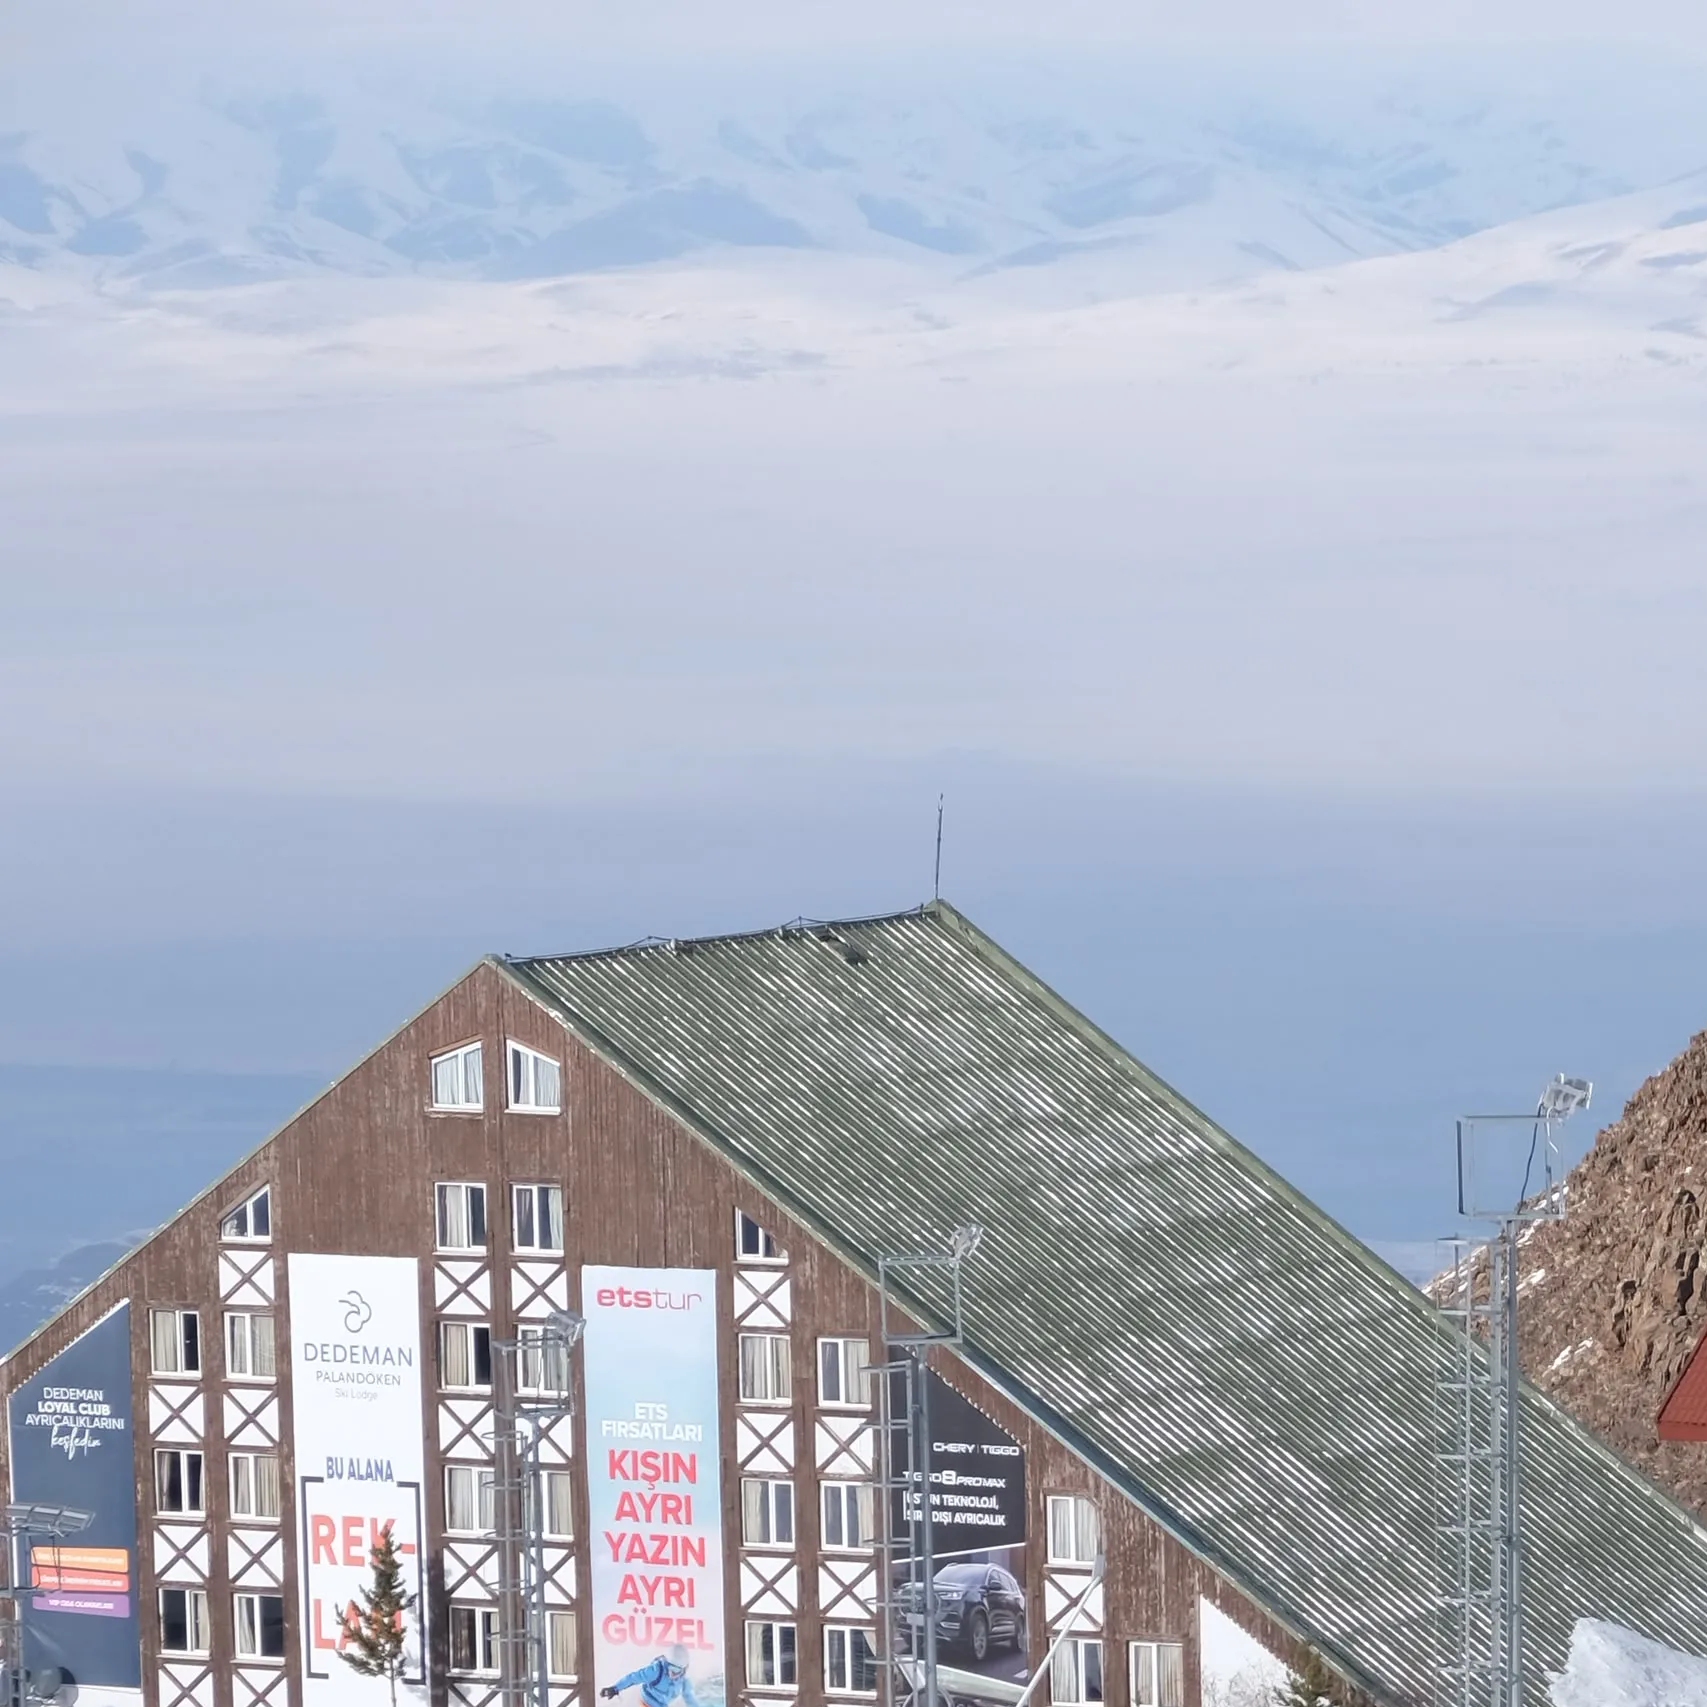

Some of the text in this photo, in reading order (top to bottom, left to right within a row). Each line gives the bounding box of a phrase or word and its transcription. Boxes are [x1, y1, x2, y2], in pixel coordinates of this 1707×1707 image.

[597, 1286, 702, 1311] etstur
[304, 1342, 413, 1367] DEDEMAN
[316, 1370, 401, 1386] PALANDÖKEN
[43, 1387, 104, 1401] DEDEMAN
[335, 1387, 378, 1401] Ski Lodge
[37, 1401, 111, 1416] LOYAL CLUB
[634, 1402, 668, 1420] ETS
[25, 1414, 125, 1429] AYRICALIKLARINI
[601, 1420, 703, 1442] FIRSATLARI
[932, 1442, 1019, 1456] CHERY TIGGO
[326, 1456, 394, 1482] BU ALANA
[608, 1449, 697, 1490] KIŞIN
[614, 1491, 692, 1525] AYRI
[953, 1511, 1006, 1526] AYRICALIK
[603, 1531, 706, 1567] YAZIN
[617, 1574, 695, 1608] AYRI
[602, 1607, 714, 1651] GÜZEL
